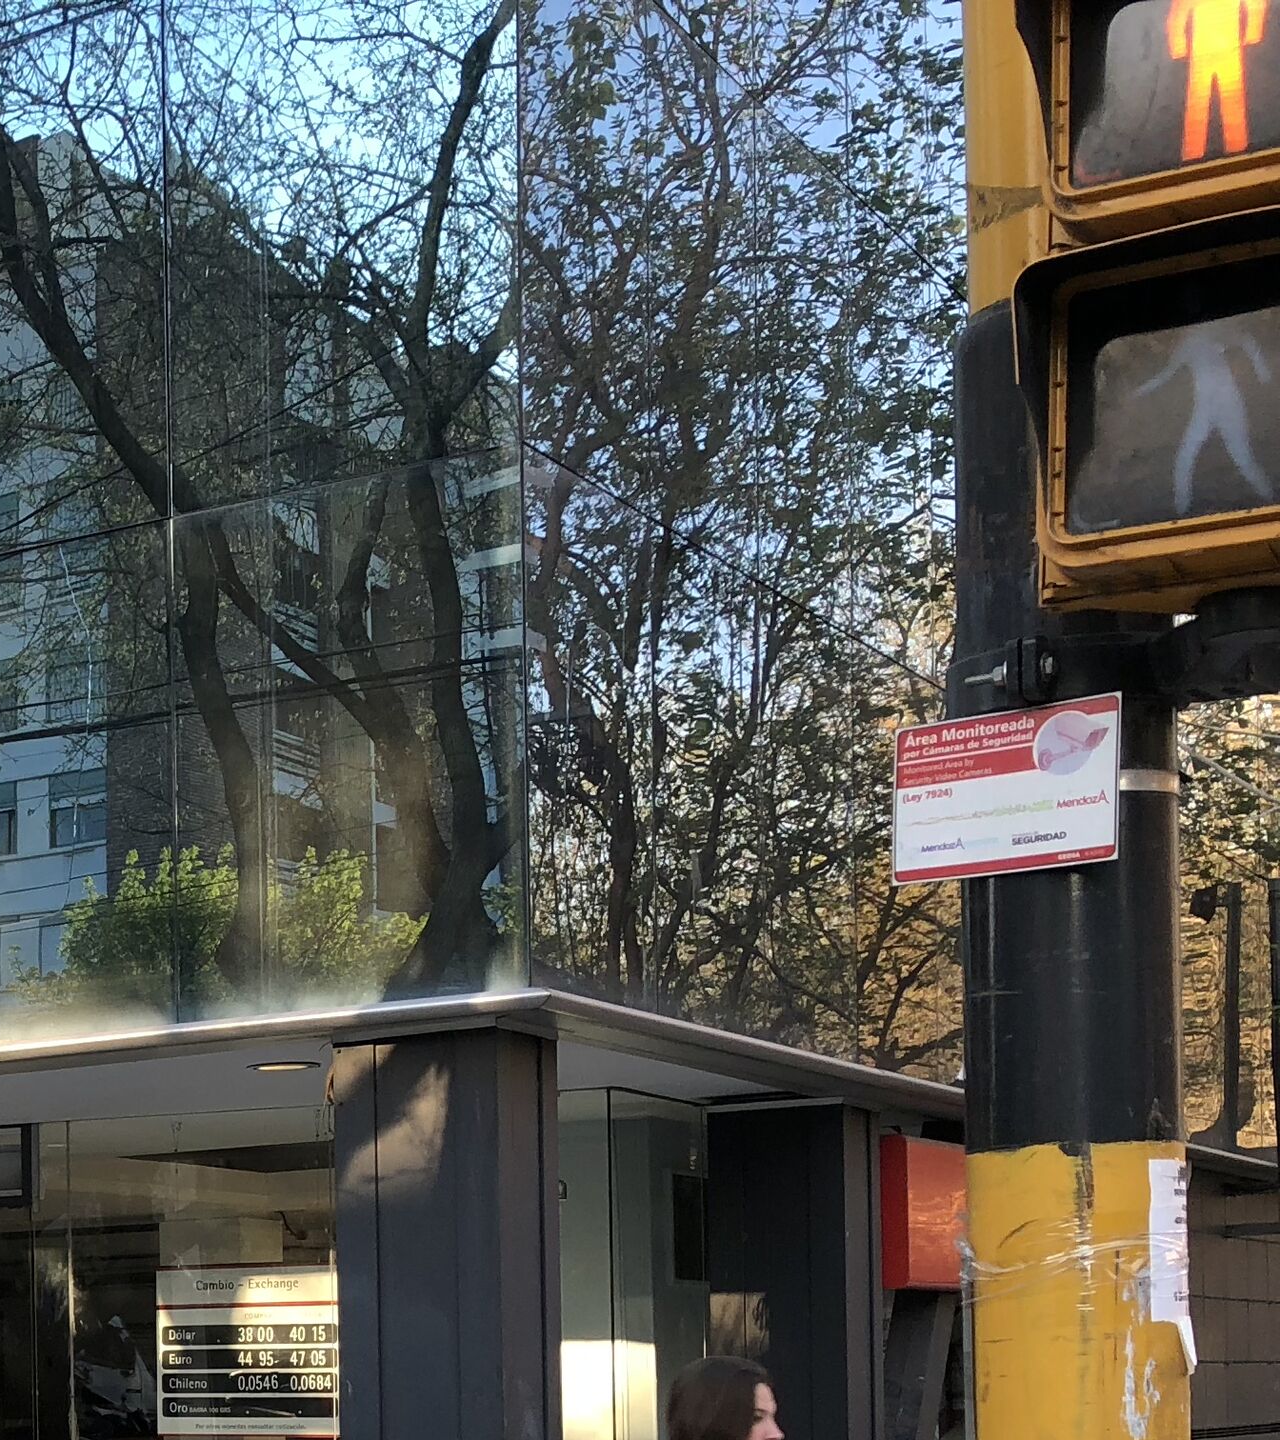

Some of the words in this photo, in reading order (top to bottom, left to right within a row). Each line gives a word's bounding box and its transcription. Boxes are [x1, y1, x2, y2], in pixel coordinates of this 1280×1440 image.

[904, 731, 938, 748] Área
[941, 716, 1035, 742] Monitoreada
[902, 748, 921, 760] por
[922, 741, 965, 756] Cámaras
[967, 739, 980, 750] de
[982, 731, 1033, 749] Seguridad
[1011, 831, 1067, 846] SEGURIDAD
[195, 1279, 235, 1292] Cambio
[248, 1278, 300, 1292] Exchange
[168, 1328, 196, 1341] Dólar
[168, 1353, 193, 1365] Euro
[168, 1377, 208, 1390] Chileno
[237, 1375, 279, 1392] 0,0546
[290, 1375, 332, 1392] 0,0684
[169, 1402, 188, 1413] Oro
